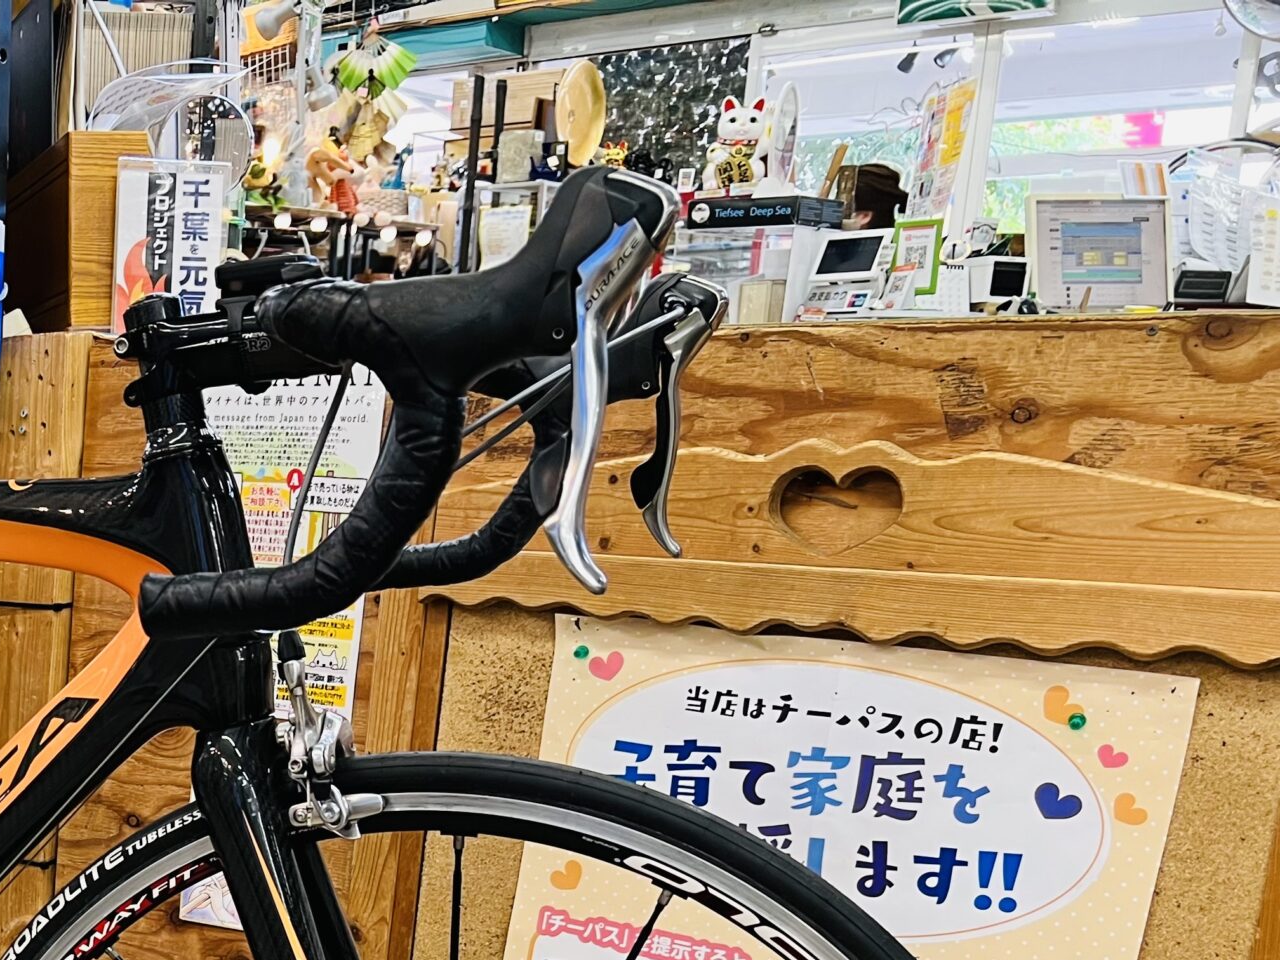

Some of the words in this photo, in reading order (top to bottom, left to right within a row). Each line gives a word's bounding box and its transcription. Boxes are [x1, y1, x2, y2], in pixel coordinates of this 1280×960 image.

[153, 176, 175, 271] プロジェクト
[714, 207, 745, 218] Tiefsee
[749, 205, 774, 219] Deep
[775, 204, 792, 216] Sea
[583, 236, 641, 312] DURA-ACE
[205, 395, 373, 408] タイナイは、世界中のアイトバ。
[214, 415, 252, 424] message
[255, 413, 276, 423] from
[278, 413, 305, 425] Japan
[308, 415, 317, 423] to
[339, 413, 370, 424] world.
[684, 684, 1004, 755] 当店はチーパスの店!
[613, 738, 991, 825] 子育て家庭を
[125, 808, 203, 856] TUBELESS
[151, 865, 202, 900] FIT
